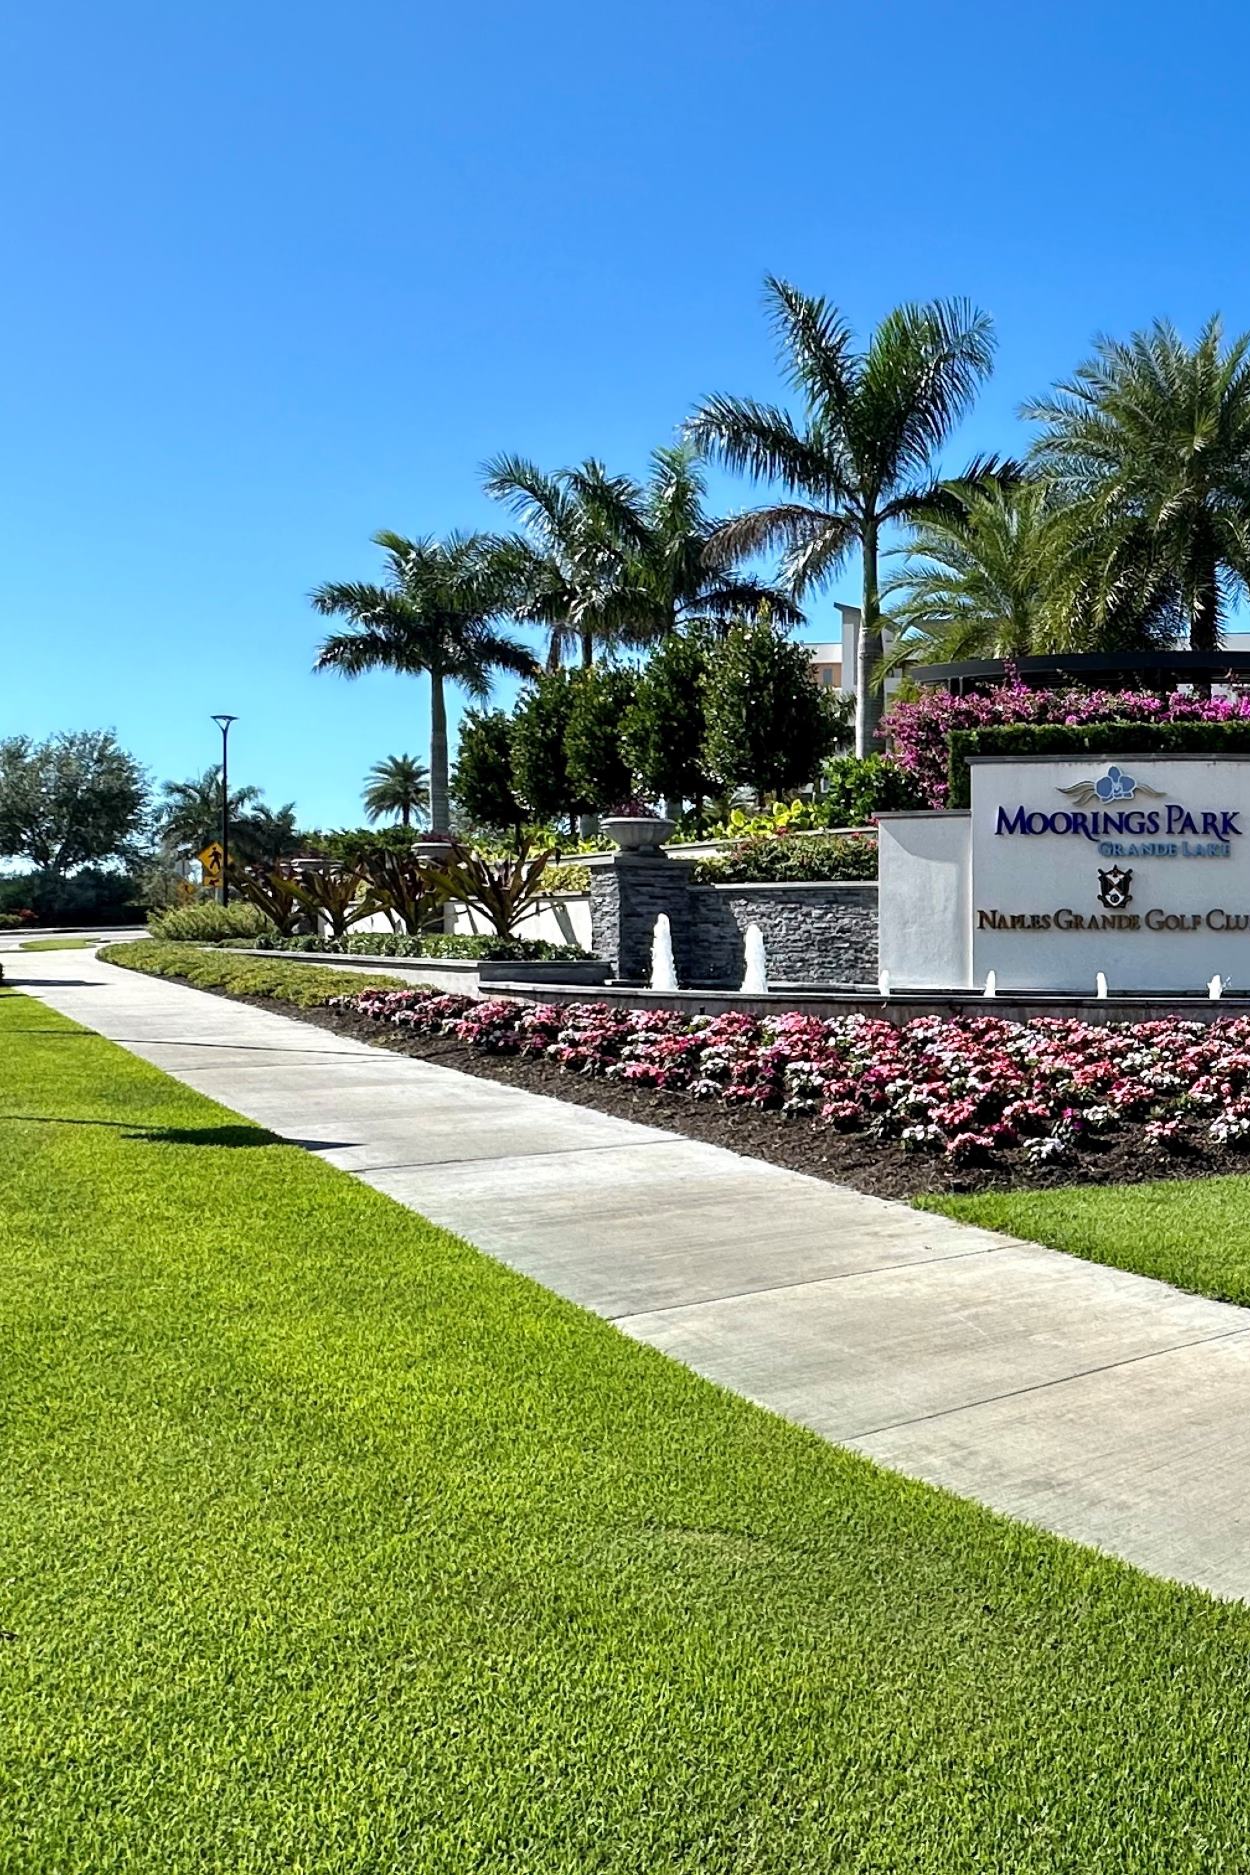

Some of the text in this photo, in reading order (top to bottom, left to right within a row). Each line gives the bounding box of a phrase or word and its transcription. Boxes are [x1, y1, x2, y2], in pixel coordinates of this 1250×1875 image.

[995, 804, 1242, 841] MOORINGS PARK
[1053, 909, 1141, 930] GRANDE
[1145, 909, 1202, 931] GOLF
